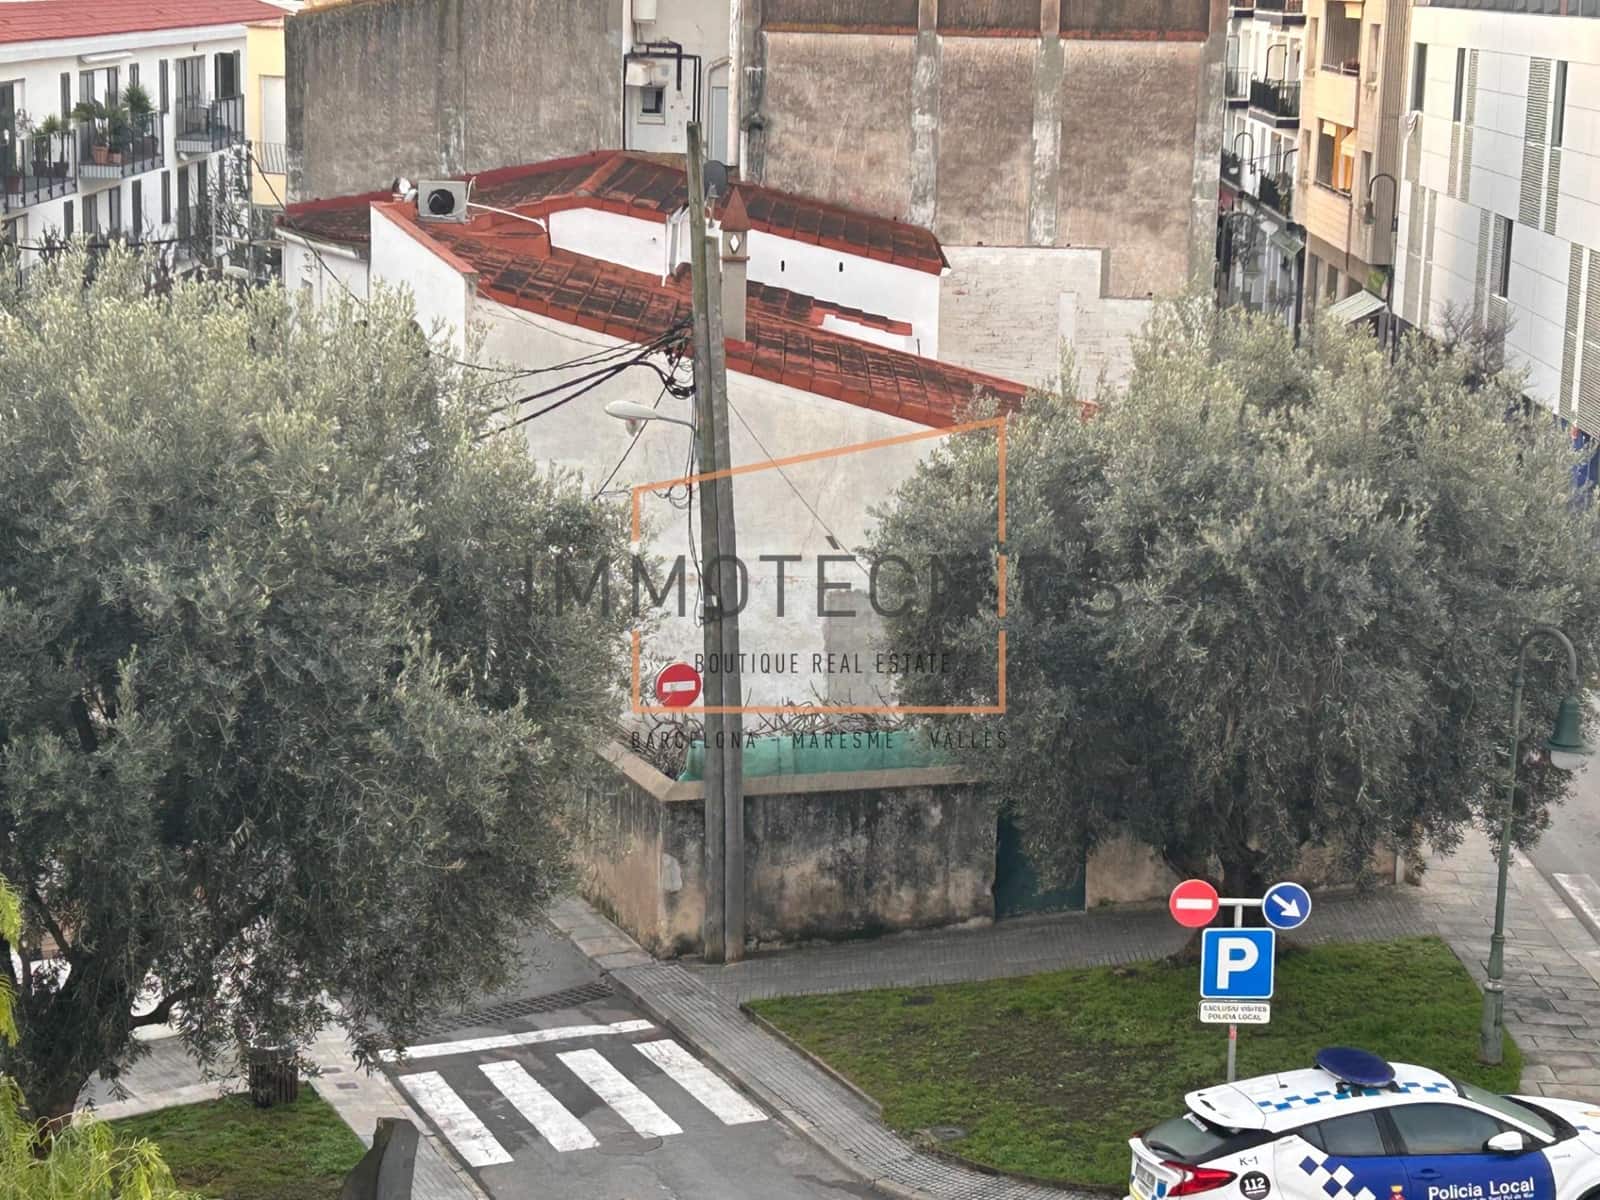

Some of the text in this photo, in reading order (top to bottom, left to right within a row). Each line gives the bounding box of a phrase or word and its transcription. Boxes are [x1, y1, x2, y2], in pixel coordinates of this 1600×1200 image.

[1217, 937, 1259, 989] P
[1239, 1156, 1258, 1166] K-1
[1244, 1177, 1266, 1190] 112
[1428, 1177, 1534, 1200] Policia Local
